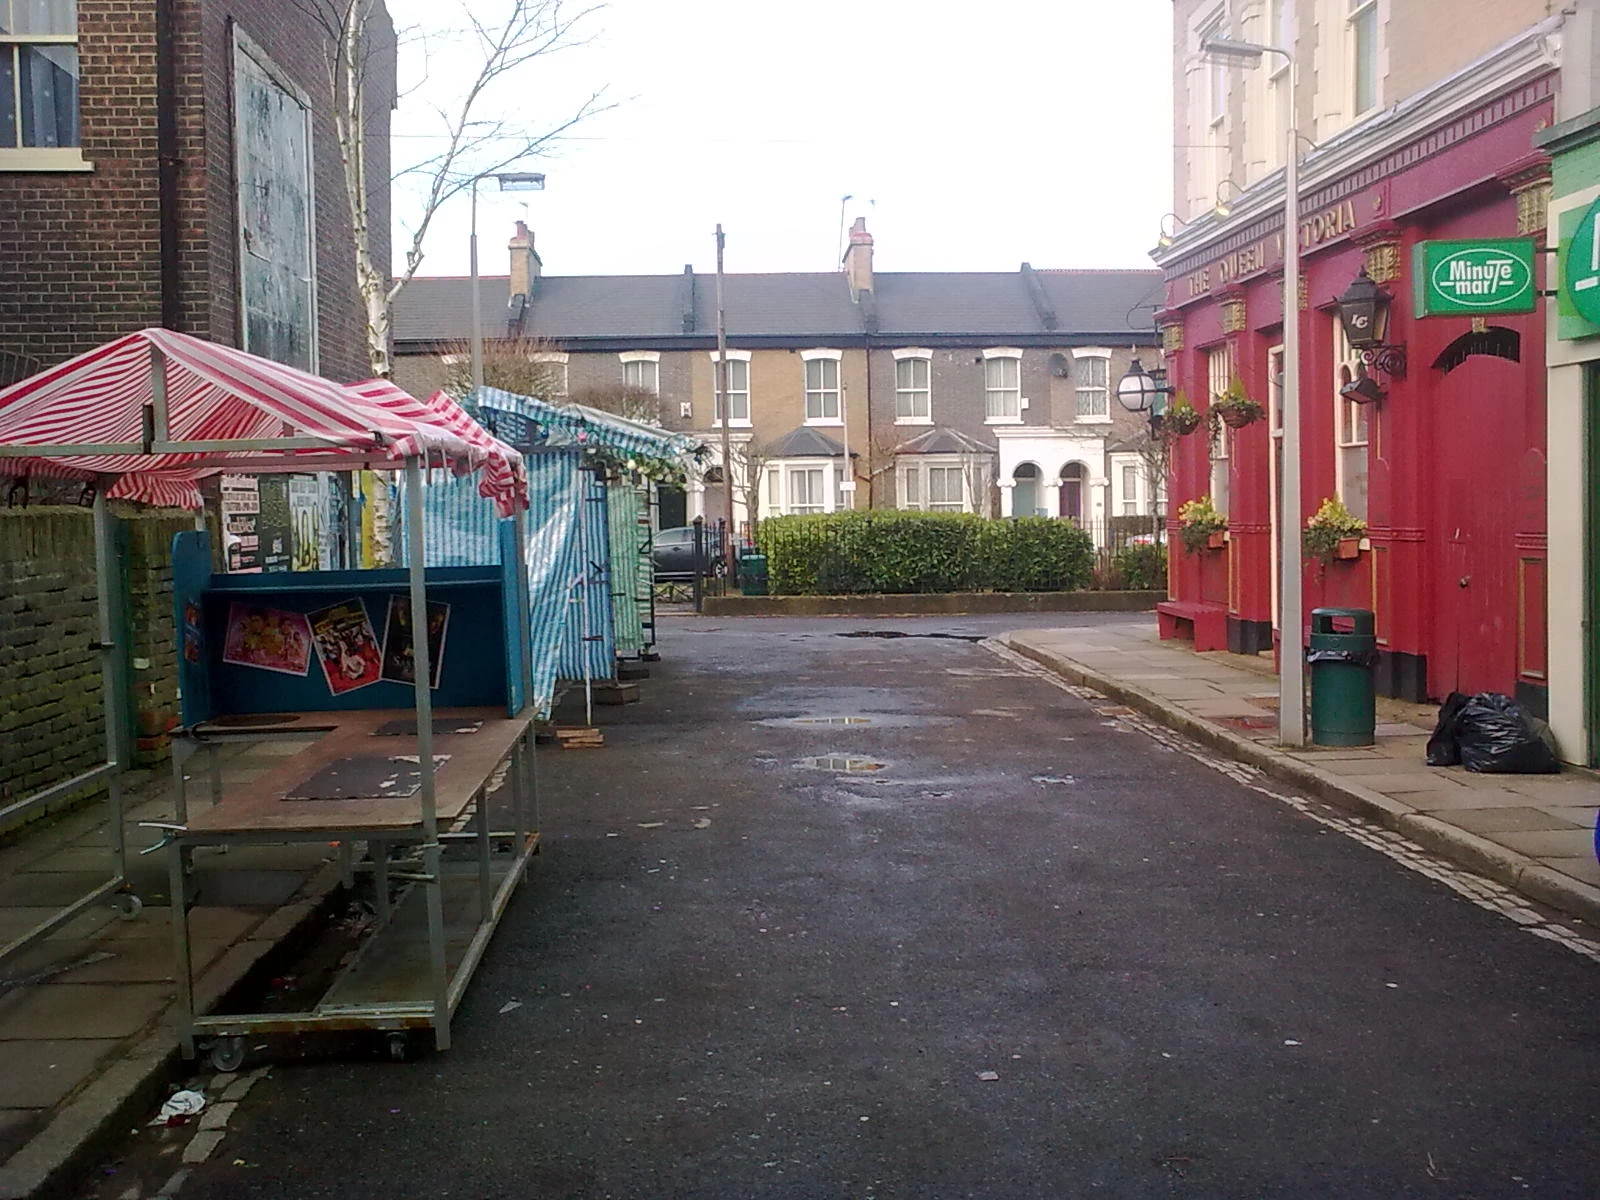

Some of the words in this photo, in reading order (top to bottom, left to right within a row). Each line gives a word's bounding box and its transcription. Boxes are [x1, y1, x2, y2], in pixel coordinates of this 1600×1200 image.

[1189, 268, 1211, 297] THE
[1219, 242, 1265, 283] QUEEN
[1275, 200, 1356, 259] VTORIA
